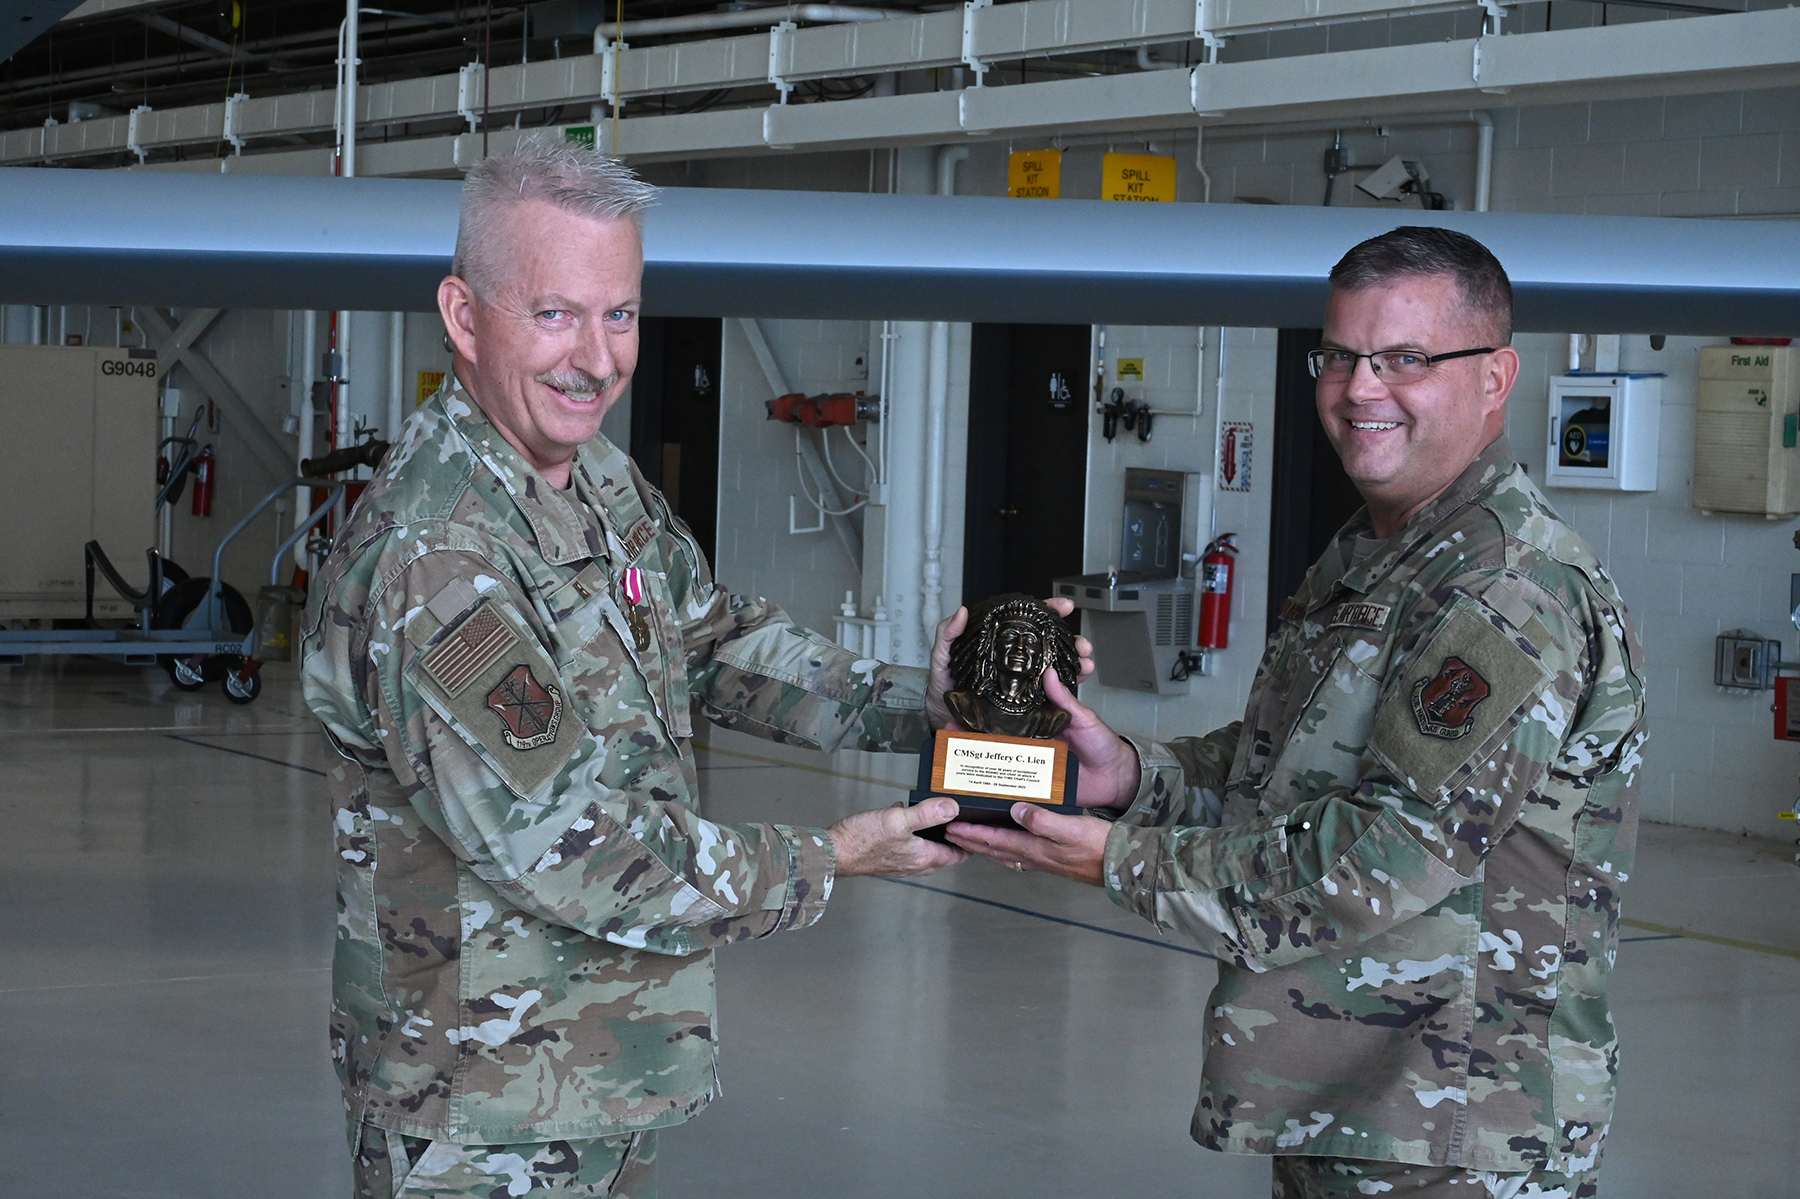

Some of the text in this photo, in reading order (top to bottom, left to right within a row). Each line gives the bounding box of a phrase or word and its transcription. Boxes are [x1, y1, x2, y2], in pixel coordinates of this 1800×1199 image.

[1022, 161, 1044, 172] SPILL
[1026, 174, 1038, 185] KIT
[1122, 169, 1151, 182] SPILL
[1016, 187, 1049, 198] STATION
[1128, 182, 1144, 194] KIT
[1731, 355, 1770, 366] First Aid
[102, 360, 156, 378] G9048
[1569, 431, 1582, 439] AED
[215, 643, 242, 653] RC02
[954, 748, 1046, 765] CMSgt Jeffery C. Lien
